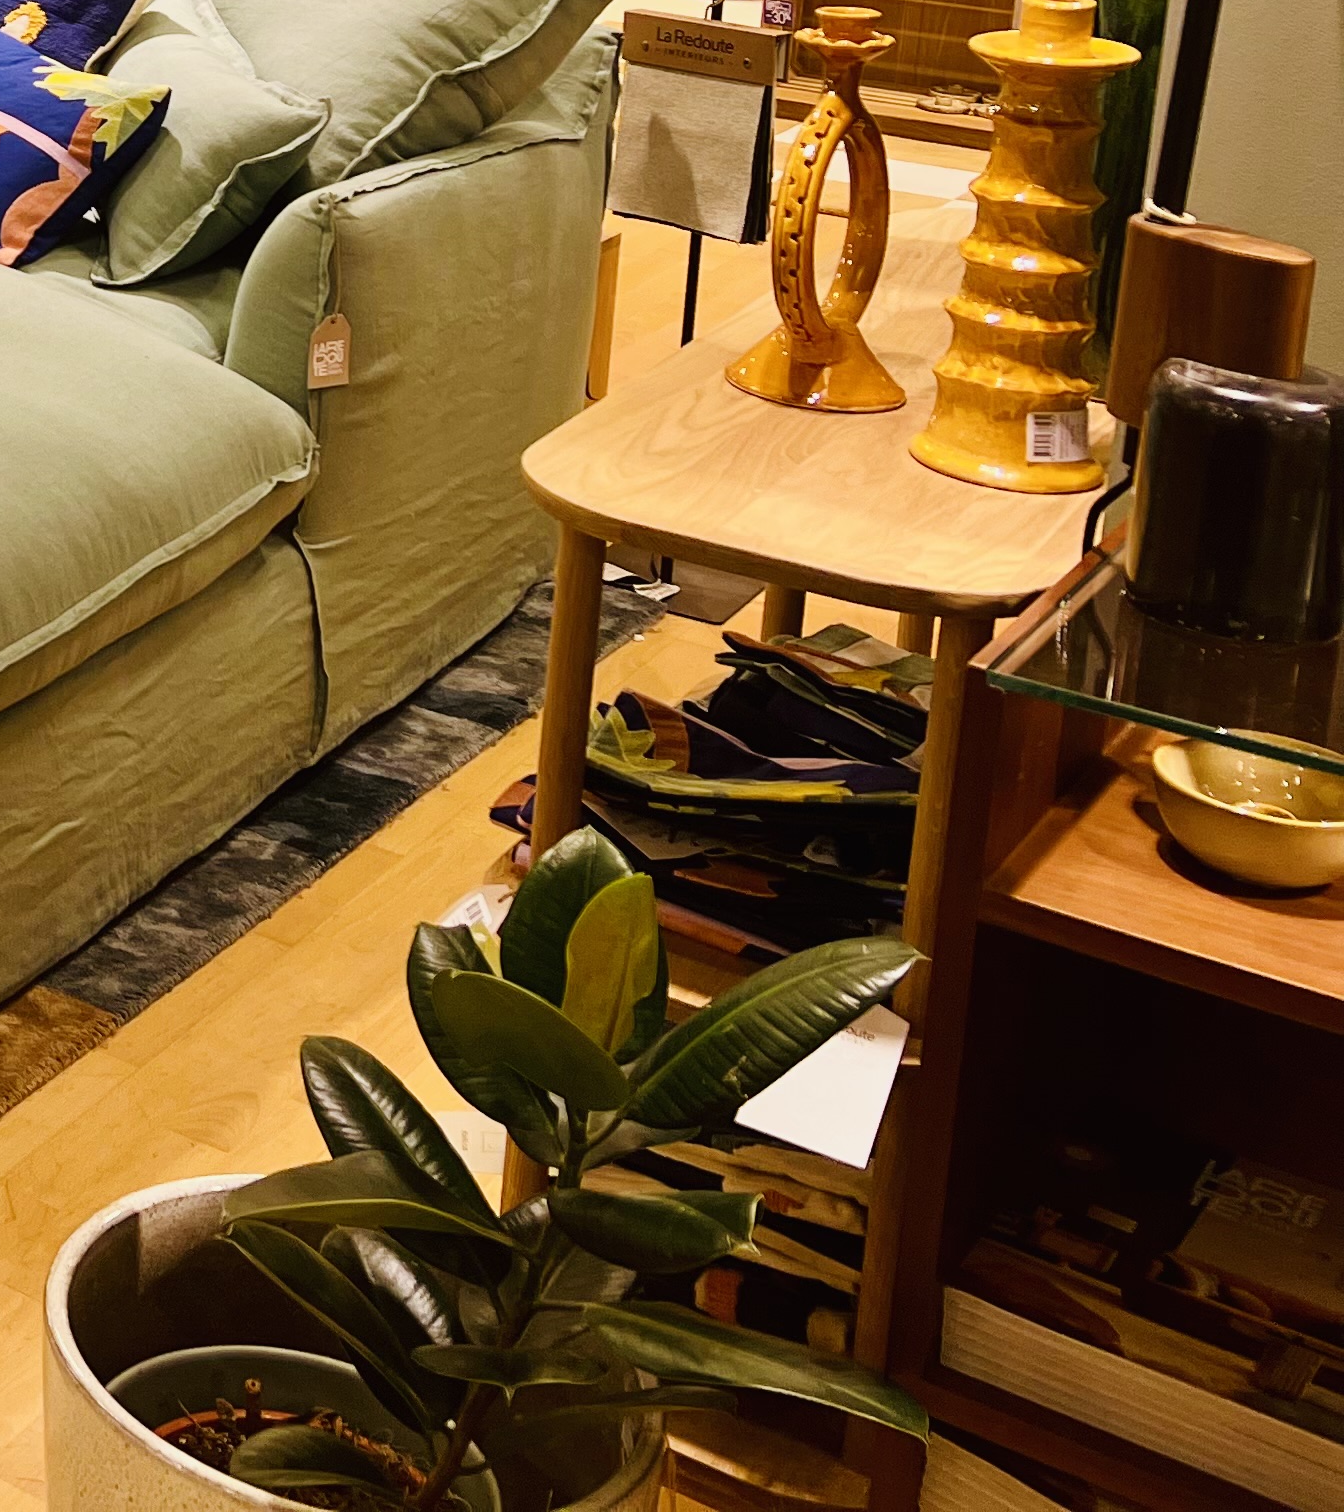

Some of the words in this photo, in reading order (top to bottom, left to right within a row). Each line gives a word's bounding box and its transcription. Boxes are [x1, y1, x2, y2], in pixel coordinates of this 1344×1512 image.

[657, 26, 672, 43] La
[674, 29, 734, 54] Redoute
[845, 1027, 875, 1041] oute
